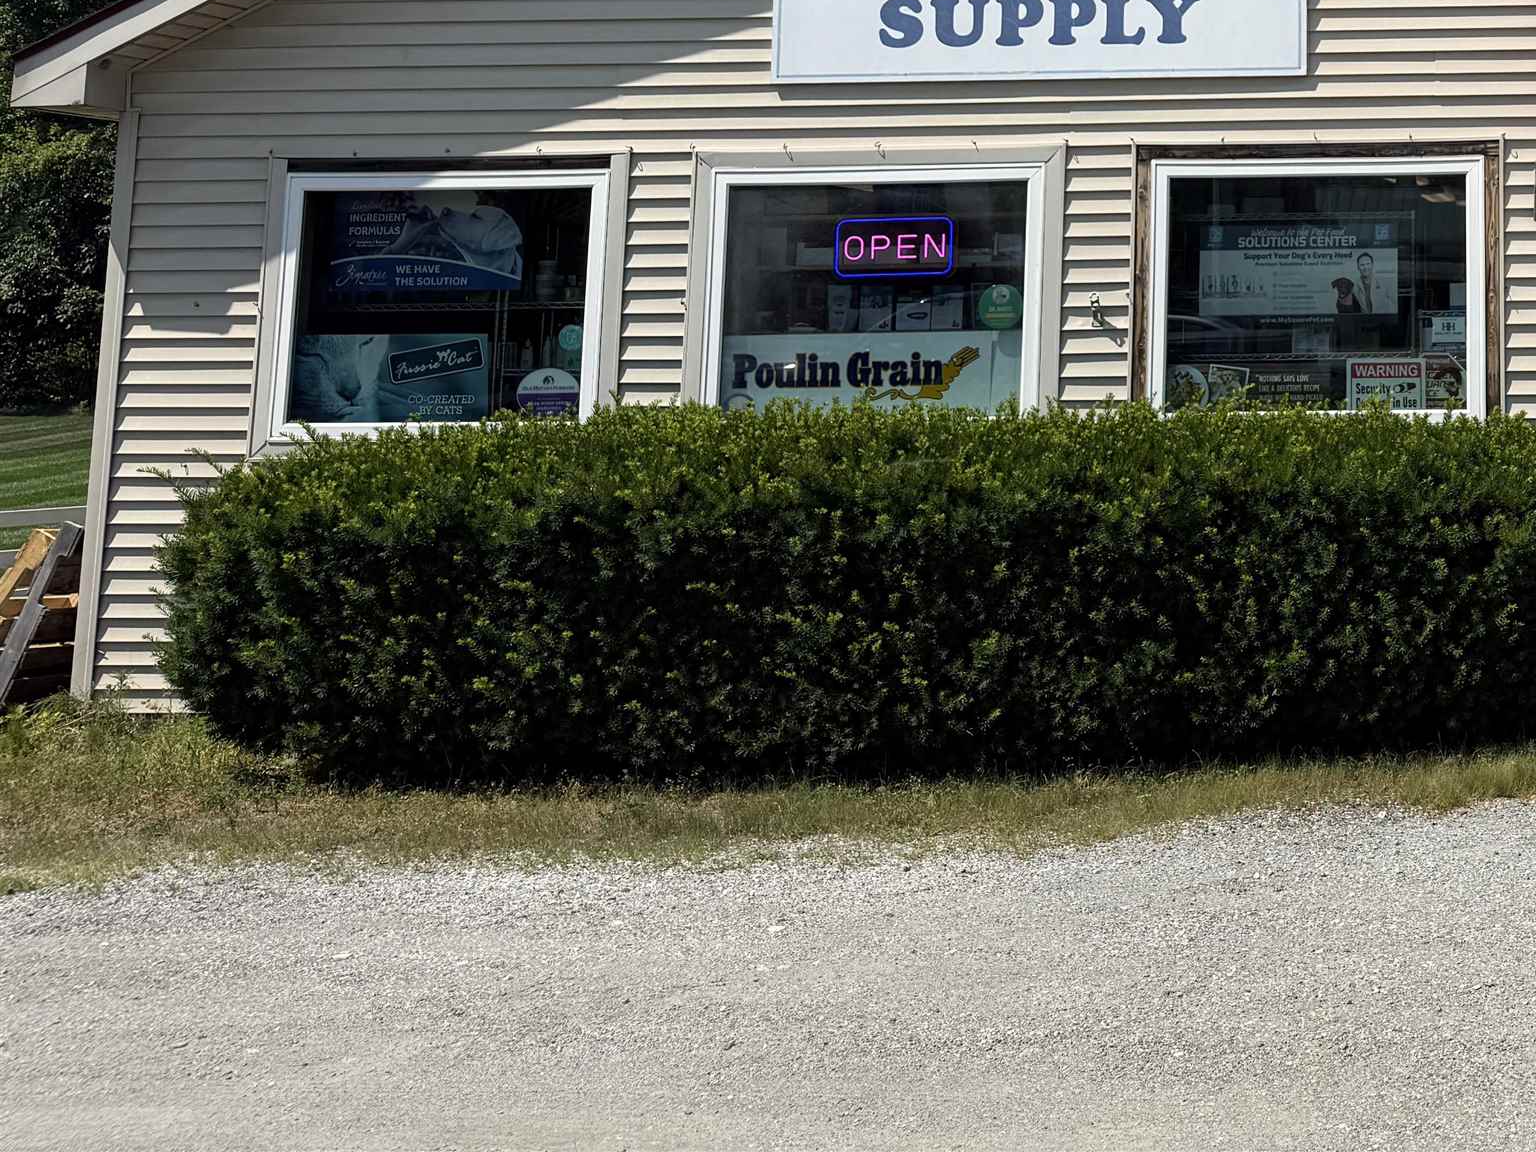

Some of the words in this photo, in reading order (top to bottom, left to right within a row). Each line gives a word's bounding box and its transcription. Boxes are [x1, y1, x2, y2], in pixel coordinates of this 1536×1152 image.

[349, 212, 407, 223] INGREDIENT
[348, 226, 401, 236] FORMULAS
[843, 233, 947, 261] OPEN
[1237, 236, 1306, 248] SOLUTIONS
[1309, 235, 1357, 247] CENTER
[395, 265, 414, 274] WE
[414, 264, 441, 273] HAVE
[395, 277, 414, 286] THE
[416, 276, 468, 286] SOLUTION
[447, 350, 476, 366] Cat
[732, 353, 841, 389] Poulin
[846, 351, 944, 388] Grain
[1356, 364, 1418, 377] WARNING
[408, 395, 475, 404] CO-CREATED
[1393, 397, 1401, 408] in
[1403, 397, 1418, 409] Use
[435, 406, 463, 415] CATS
